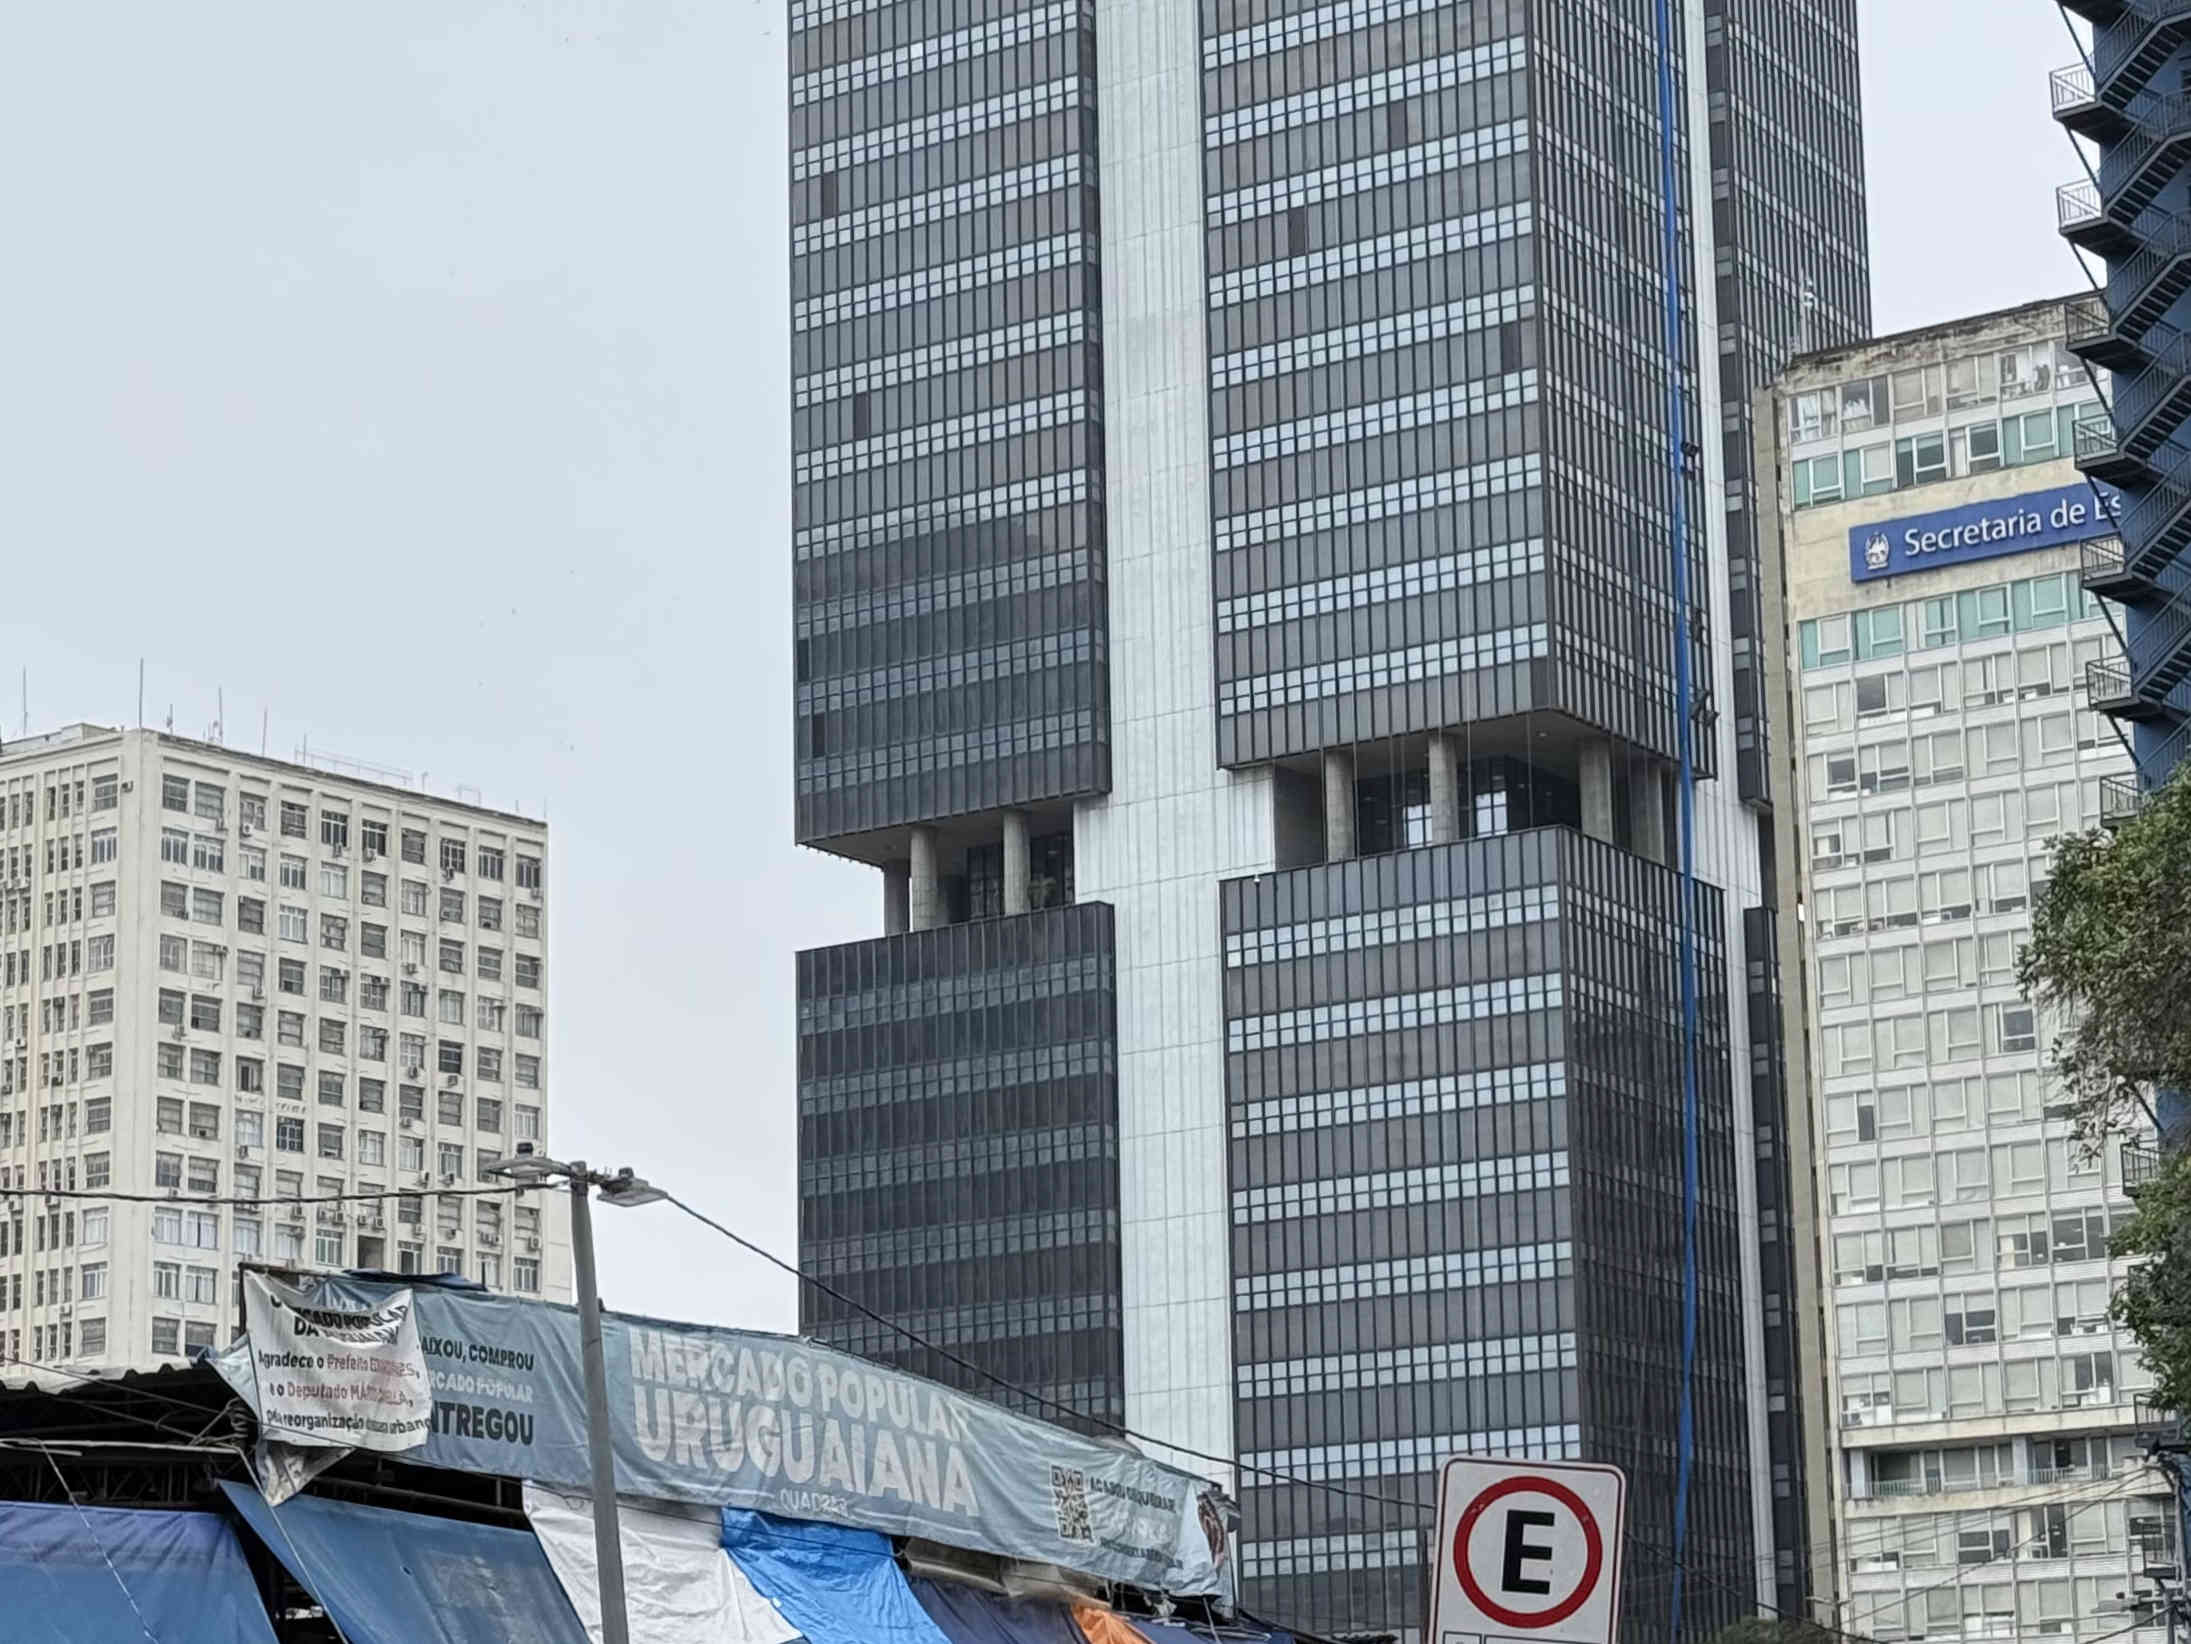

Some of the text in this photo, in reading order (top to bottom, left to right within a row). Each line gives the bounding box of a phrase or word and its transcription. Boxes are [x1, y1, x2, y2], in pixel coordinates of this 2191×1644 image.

[1904, 508, 2042, 557] Secretaria
[2050, 498, 2086, 529] de
[316, 1356, 325, 1369] o
[421, 1336, 466, 1363] AIXOU,
[468, 1344, 534, 1371] COMPROU
[628, 1326, 814, 1408] MERCADO
[430, 1400, 534, 1446] NTREGOU
[632, 1385, 981, 1517] URUGUAIANA
[1501, 1509, 1555, 1595] E
